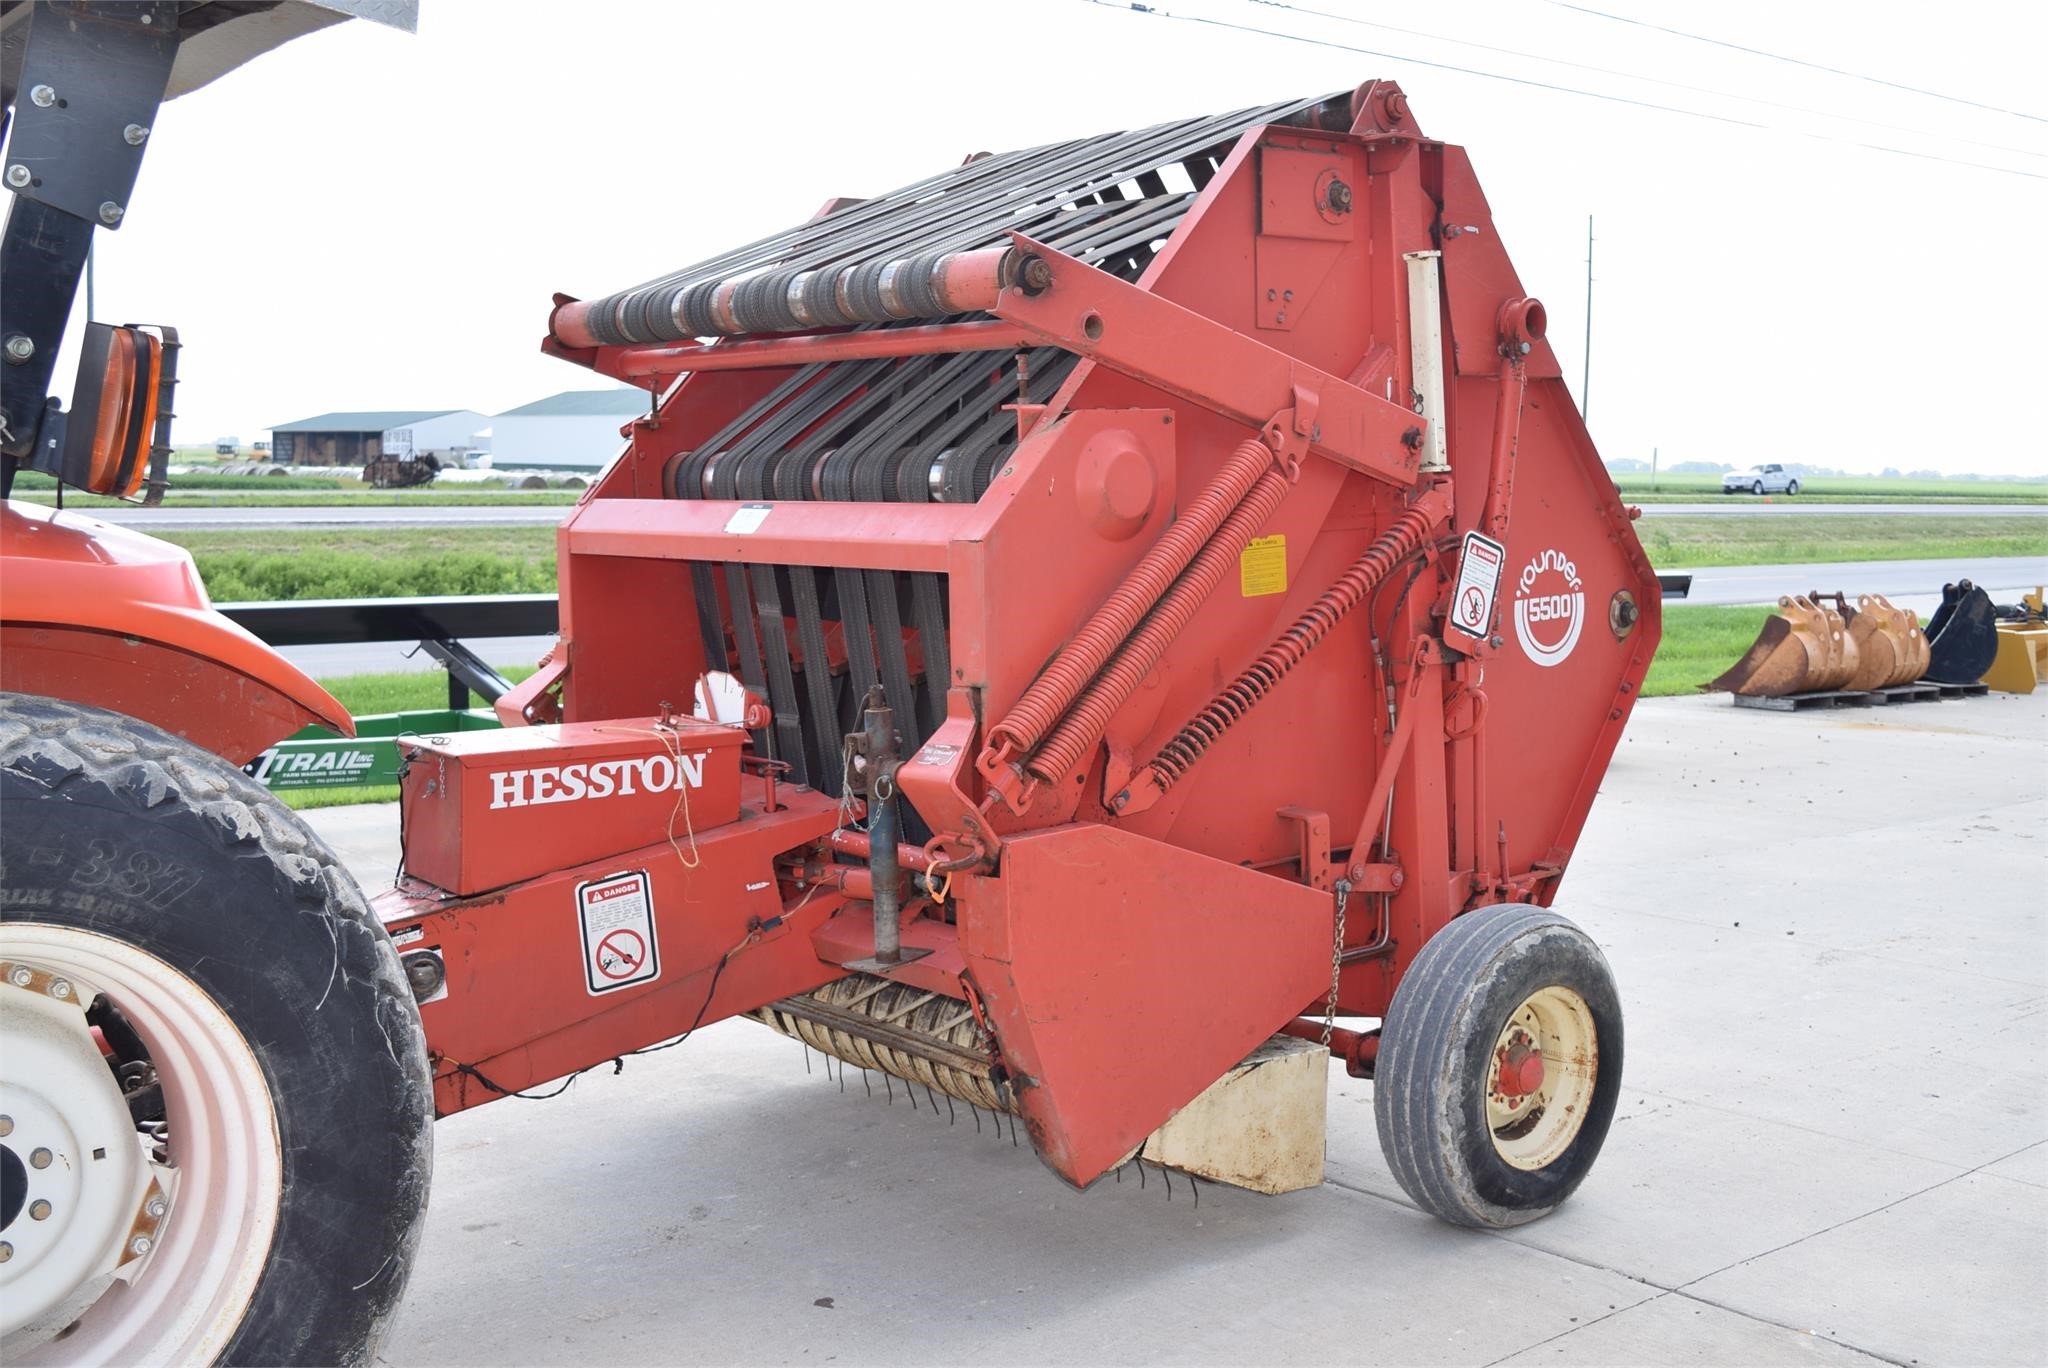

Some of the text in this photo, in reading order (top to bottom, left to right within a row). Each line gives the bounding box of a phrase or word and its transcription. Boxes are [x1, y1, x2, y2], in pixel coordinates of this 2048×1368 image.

[1529, 593, 1571, 622] 5500
[273, 750, 373, 773] TRAIL
[490, 753, 706, 810] HESSTON
[603, 883, 637, 897] DANGER
